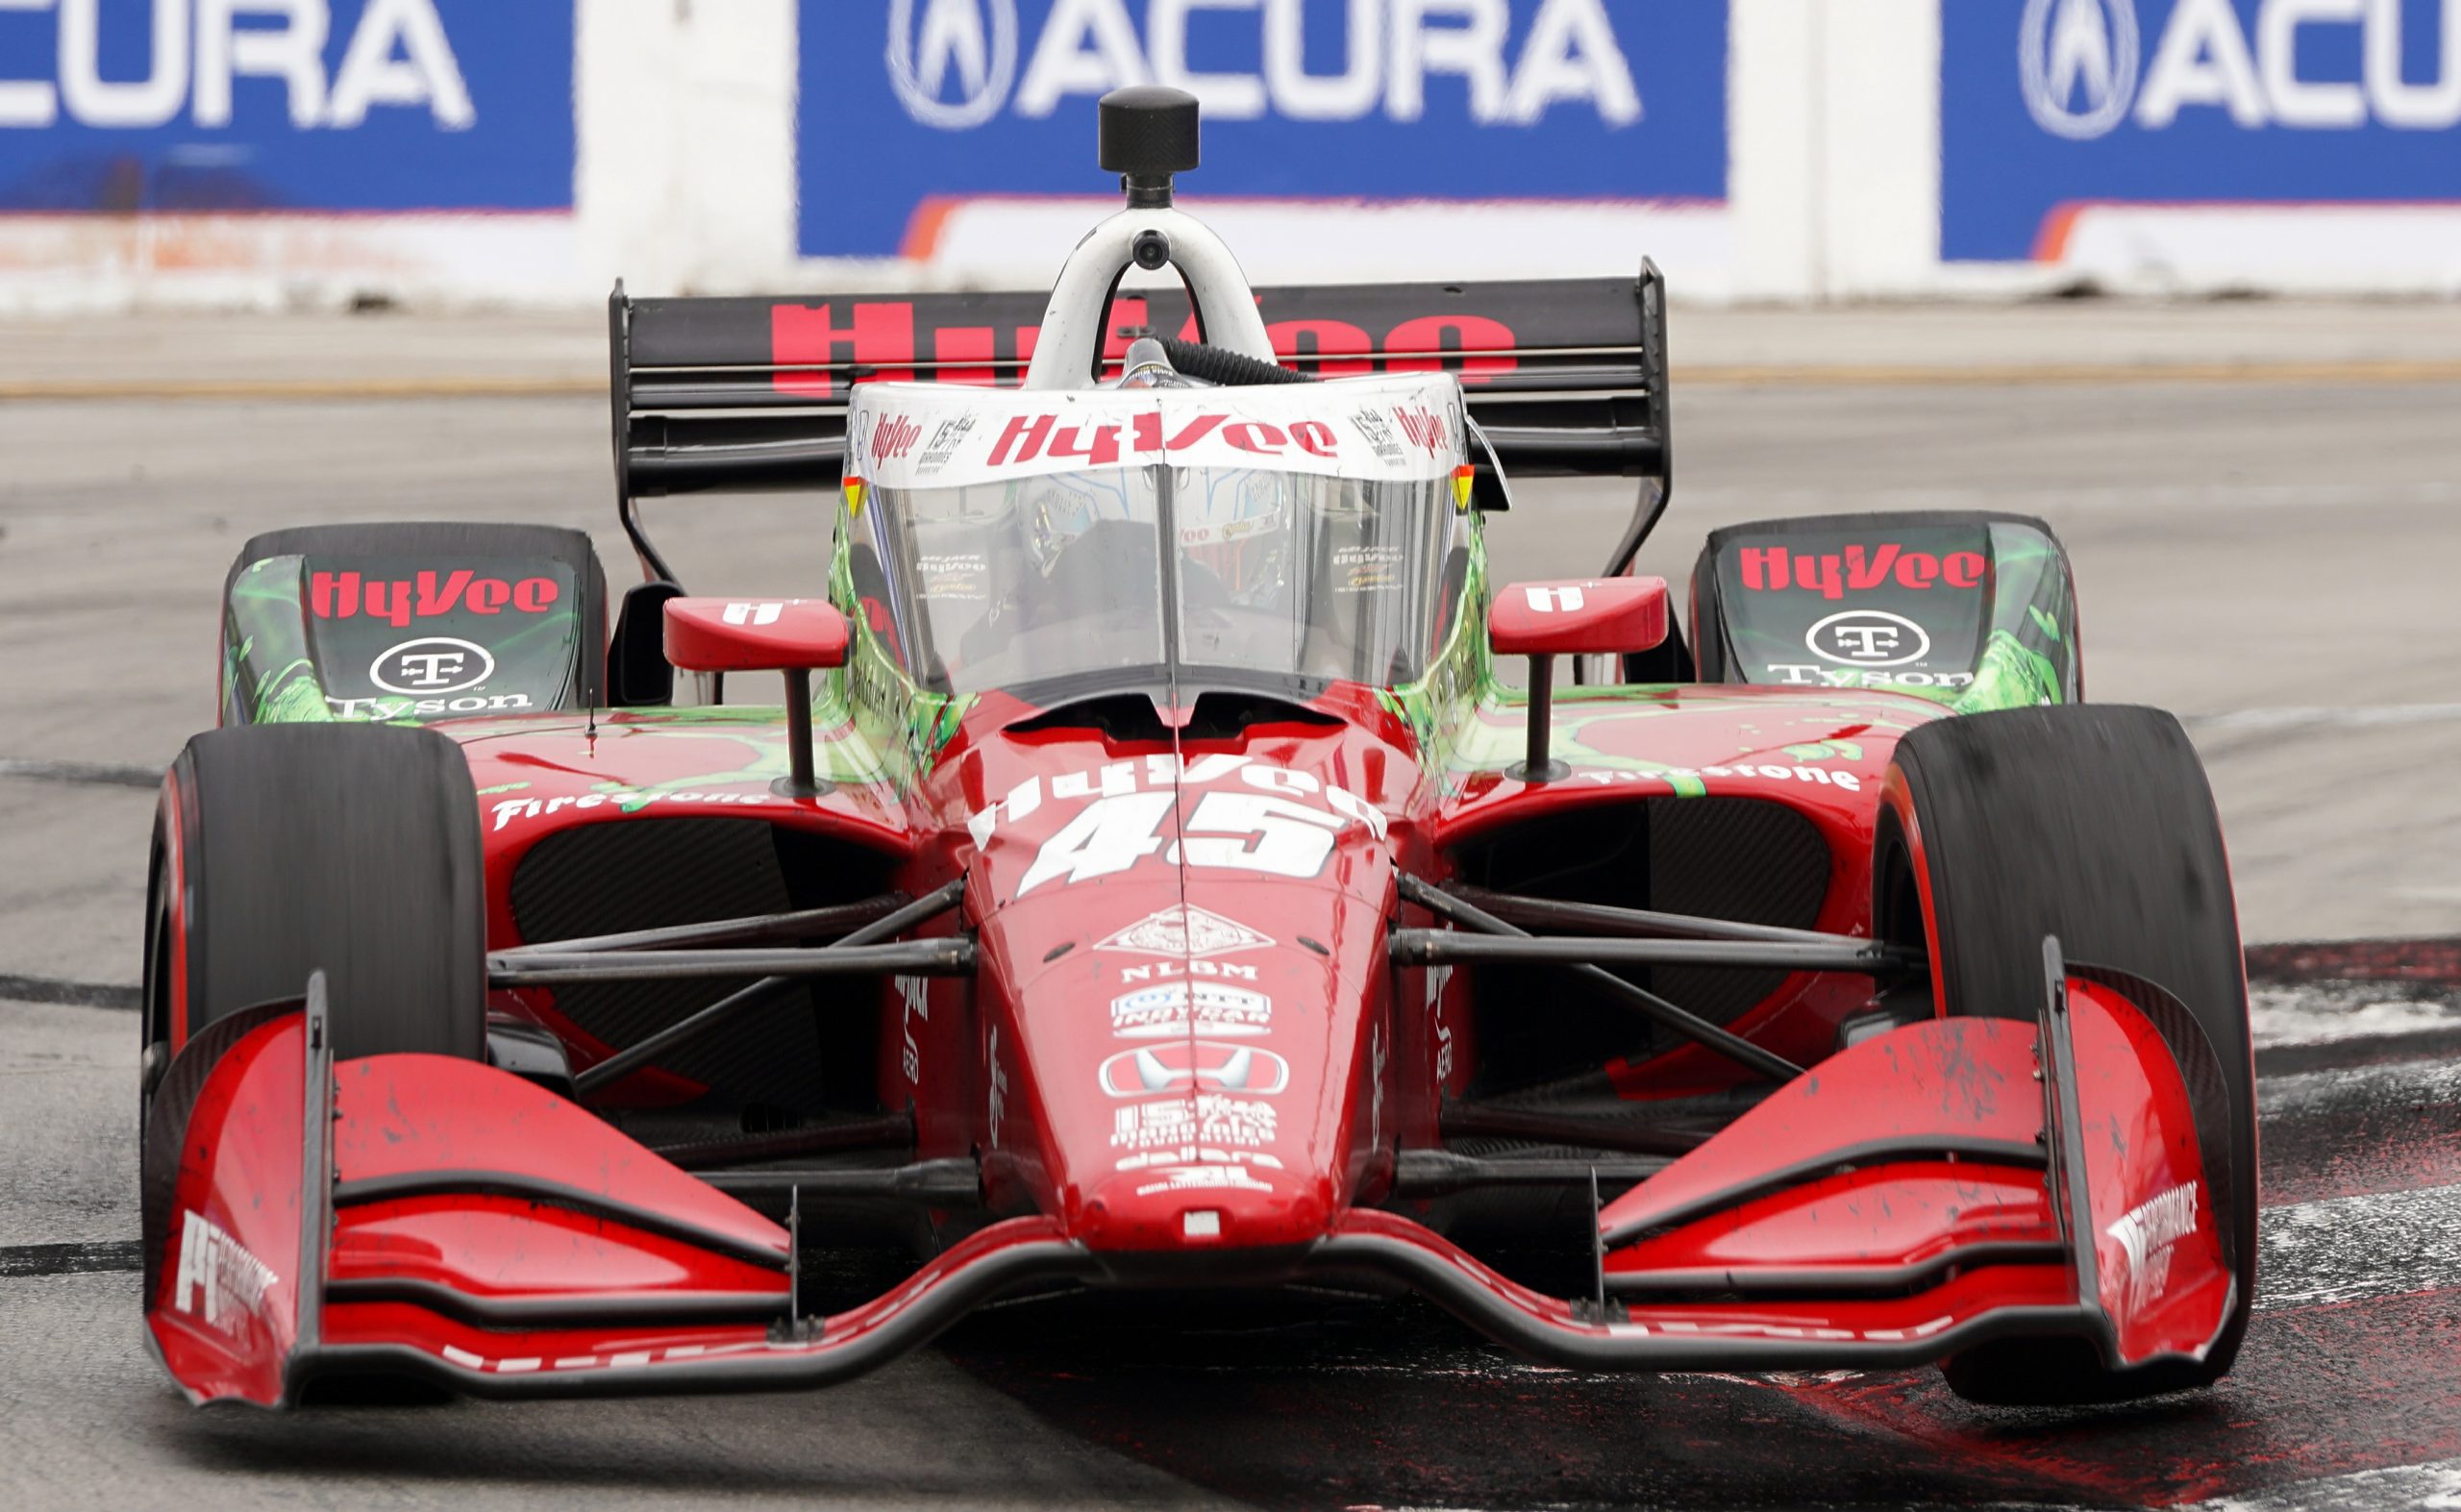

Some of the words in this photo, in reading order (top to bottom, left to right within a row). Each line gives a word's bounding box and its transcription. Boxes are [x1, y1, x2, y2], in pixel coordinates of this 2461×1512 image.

[1014, 0, 1644, 125] ACURA
[2134, 0, 2461, 129] ACU
[872, 412, 922, 469] HyVee
[986, 412, 1338, 466] HyVee
[1391, 406, 1448, 459] HyVee
[311, 570, 559, 628] HyVee
[1740, 544, 1985, 600] HyVee
[1767, 663, 1976, 687] Tyson
[324, 693, 533, 721] Tyson
[967, 753, 1388, 853] HyVee
[1578, 763, 1861, 792] Firestone
[490, 791, 771, 831] Firestone
[1015, 791, 1348, 899] 45
[1121, 960, 1259, 984] NLBM
[1112, 1004, 1271, 1029] INDYCAR
